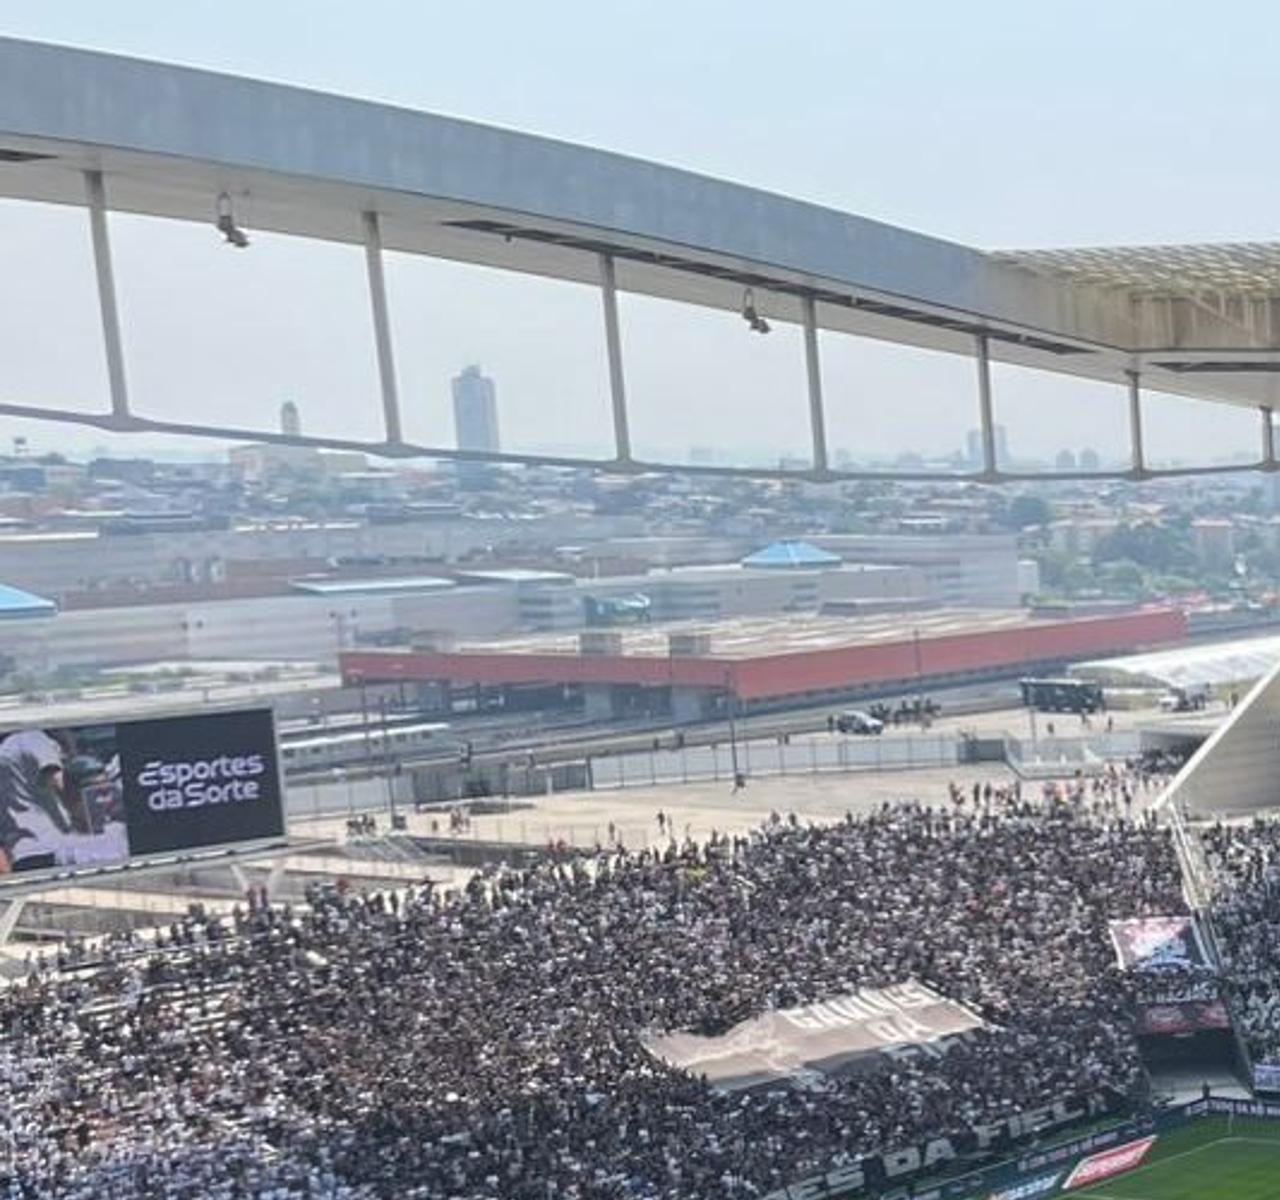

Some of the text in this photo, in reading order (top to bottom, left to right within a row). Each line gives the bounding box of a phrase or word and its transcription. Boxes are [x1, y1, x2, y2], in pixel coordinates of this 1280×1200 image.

[137, 753, 264, 788] Esportes
[149, 779, 260, 812] da Sorte
